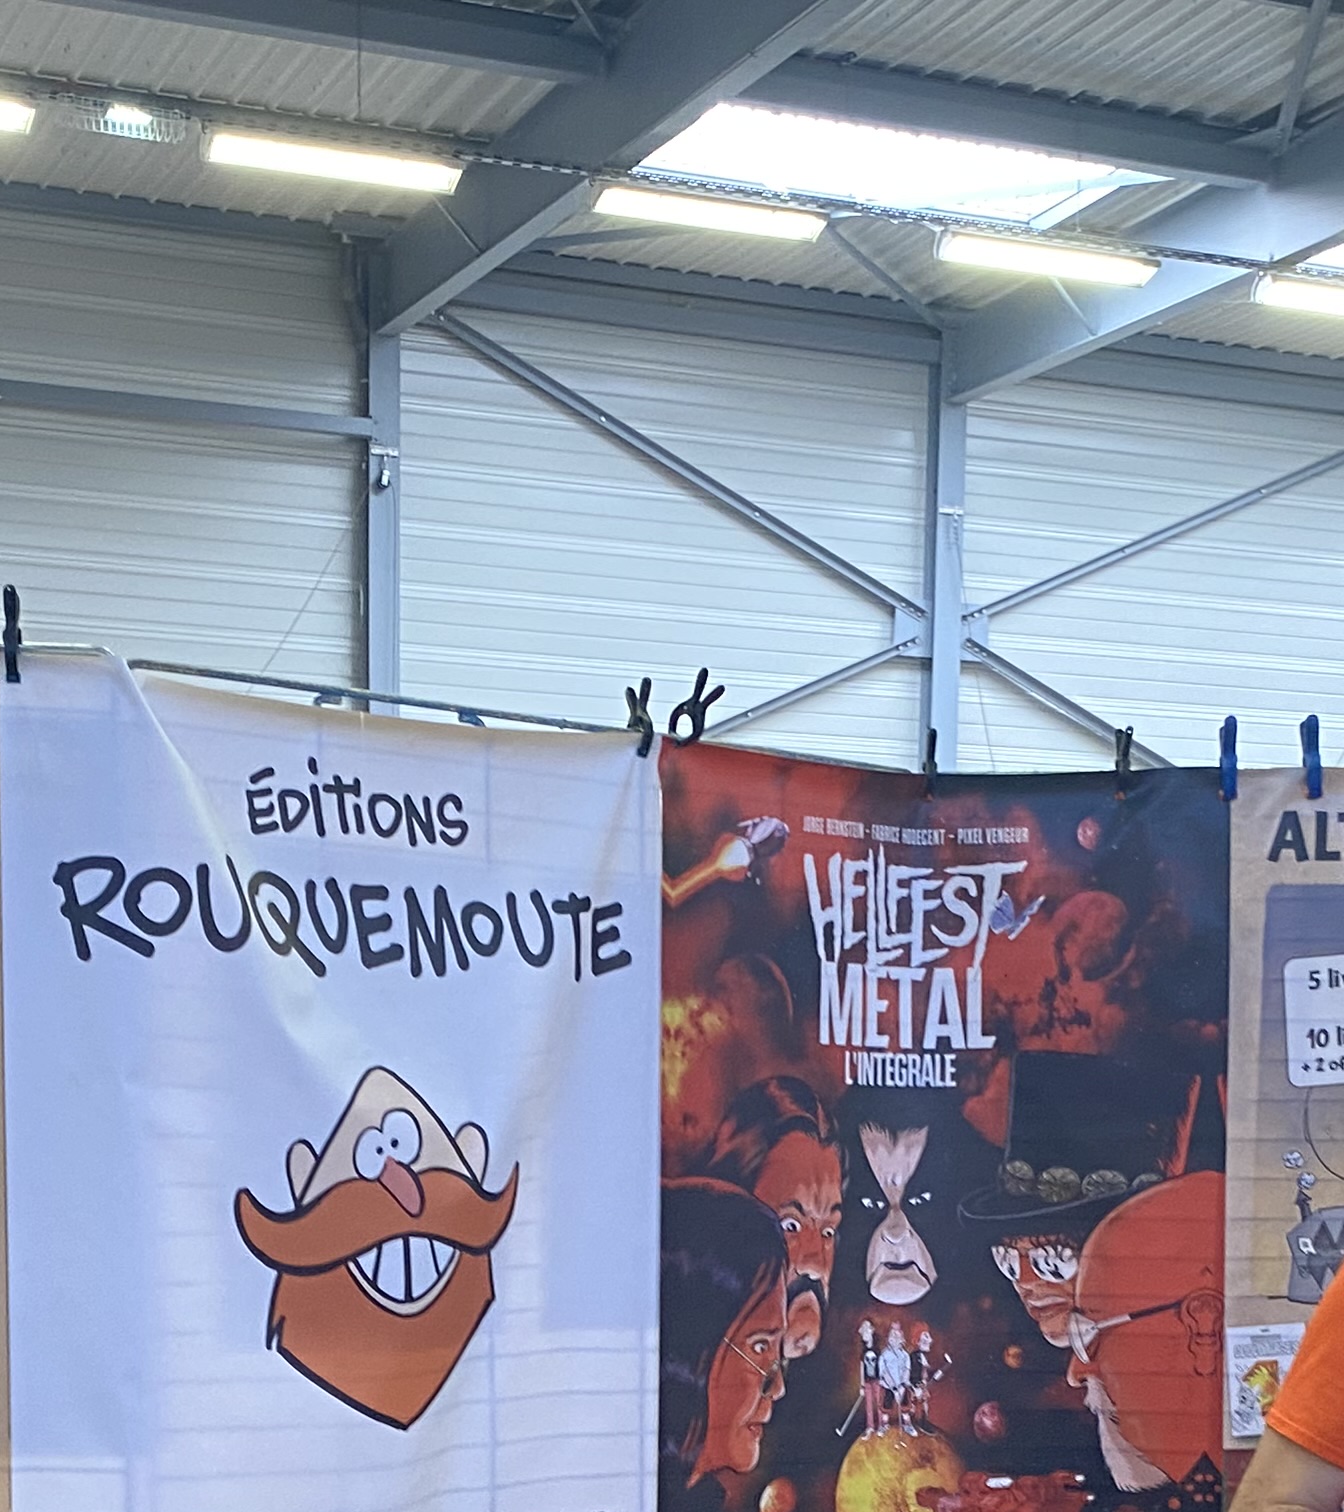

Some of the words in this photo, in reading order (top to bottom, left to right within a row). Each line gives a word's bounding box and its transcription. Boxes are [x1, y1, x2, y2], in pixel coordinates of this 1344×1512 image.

[52, 853, 633, 982] ROUQUEMOUTE
[803, 842, 1029, 978] HELLFEST
[818, 962, 997, 1051] METAL
[1308, 970, 1321, 990] 5
[1307, 1029, 1329, 1049] 10
